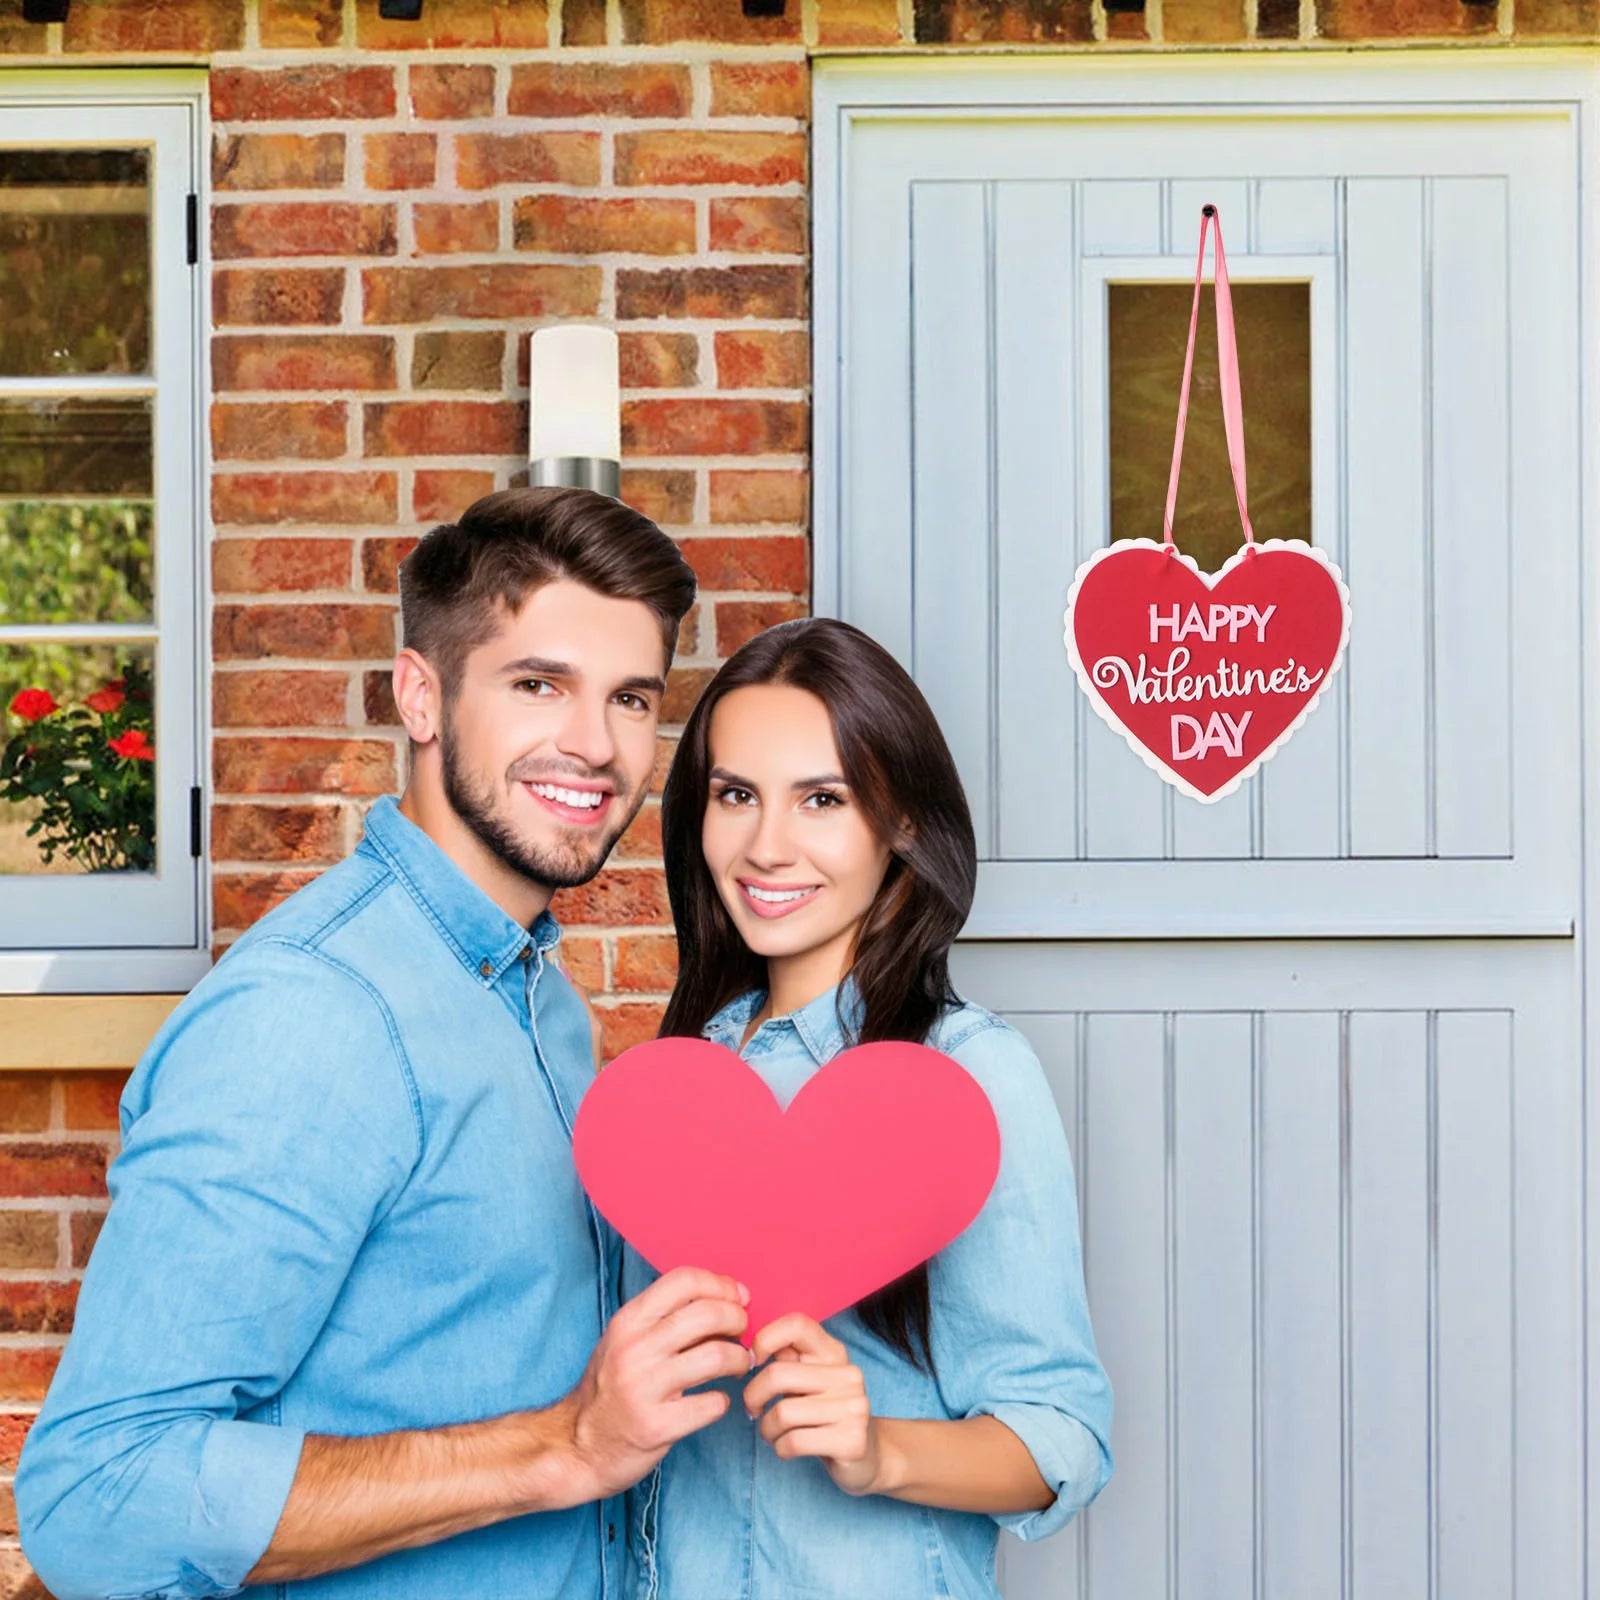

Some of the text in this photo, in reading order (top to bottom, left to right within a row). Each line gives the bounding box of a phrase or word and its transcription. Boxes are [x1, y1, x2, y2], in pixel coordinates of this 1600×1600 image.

[1150, 602, 1277, 643] HAPPY
[1092, 646, 1324, 704] Valentine's
[1170, 711, 1253, 761] DAY
